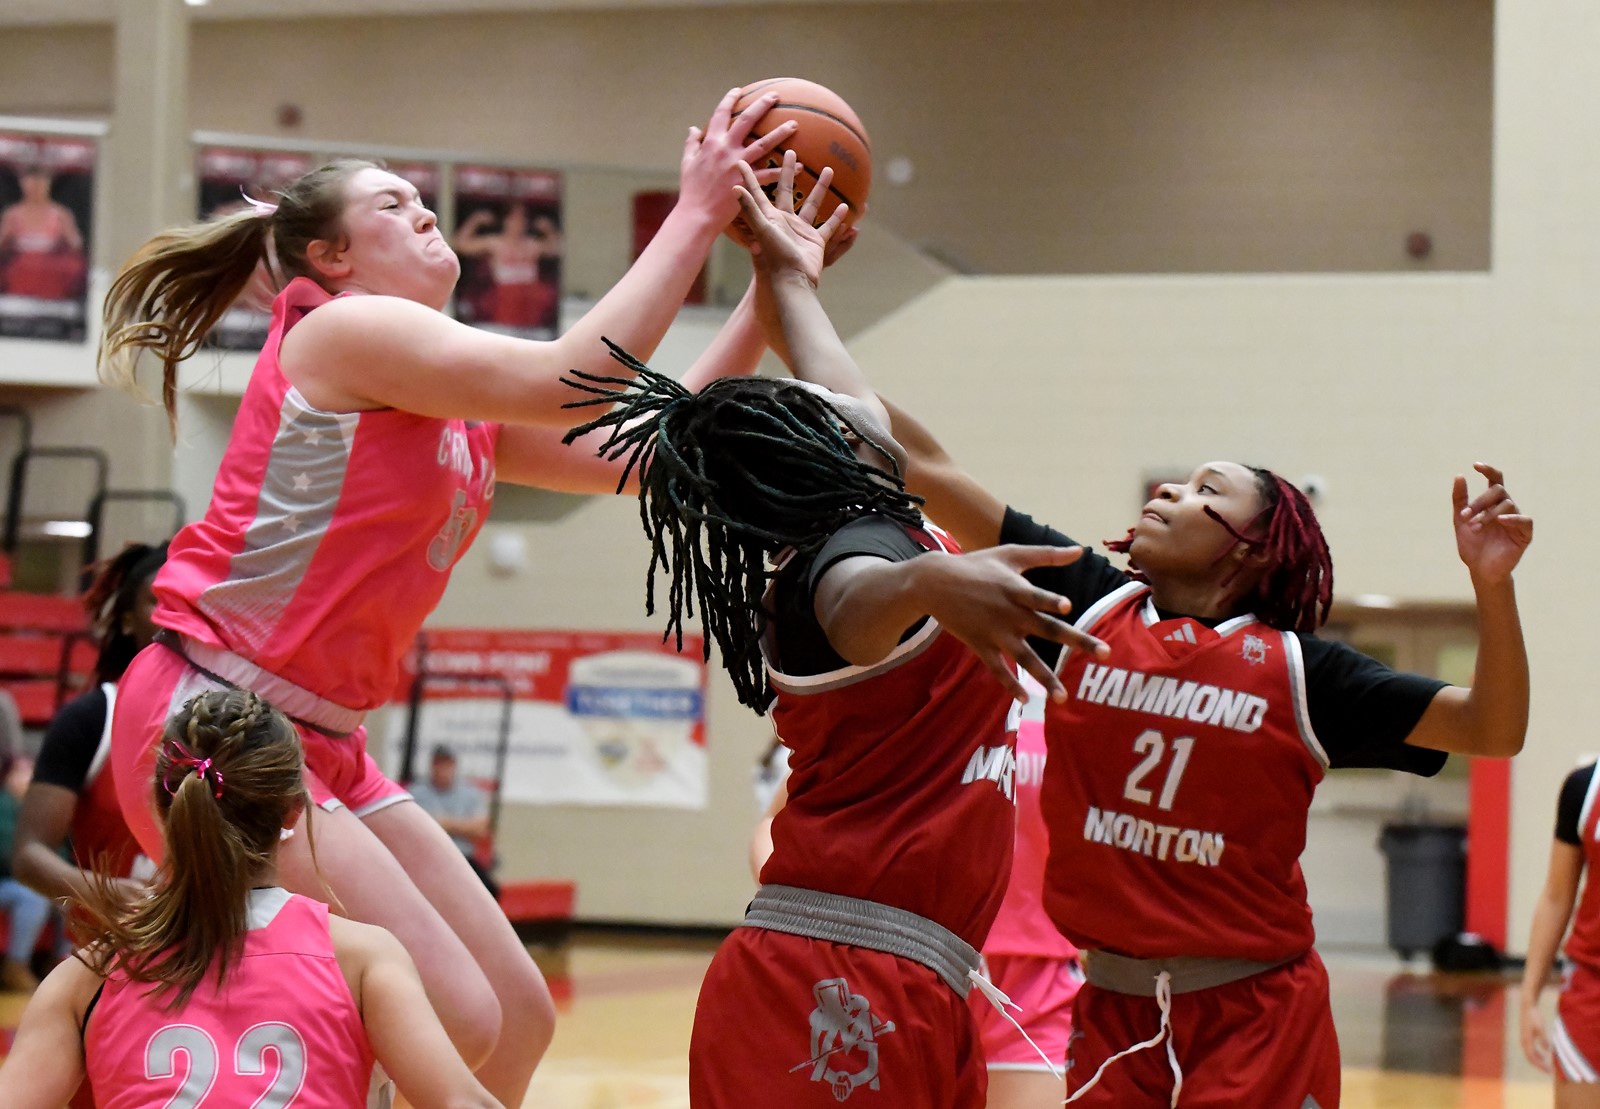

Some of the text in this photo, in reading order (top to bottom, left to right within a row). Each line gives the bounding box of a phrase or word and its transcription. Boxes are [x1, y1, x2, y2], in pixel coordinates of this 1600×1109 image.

[1076, 663, 1269, 734] HAMMOND
[1123, 728, 1197, 811] 21
[1084, 805, 1225, 867] MORTON
[144, 1021, 307, 1109] 22
